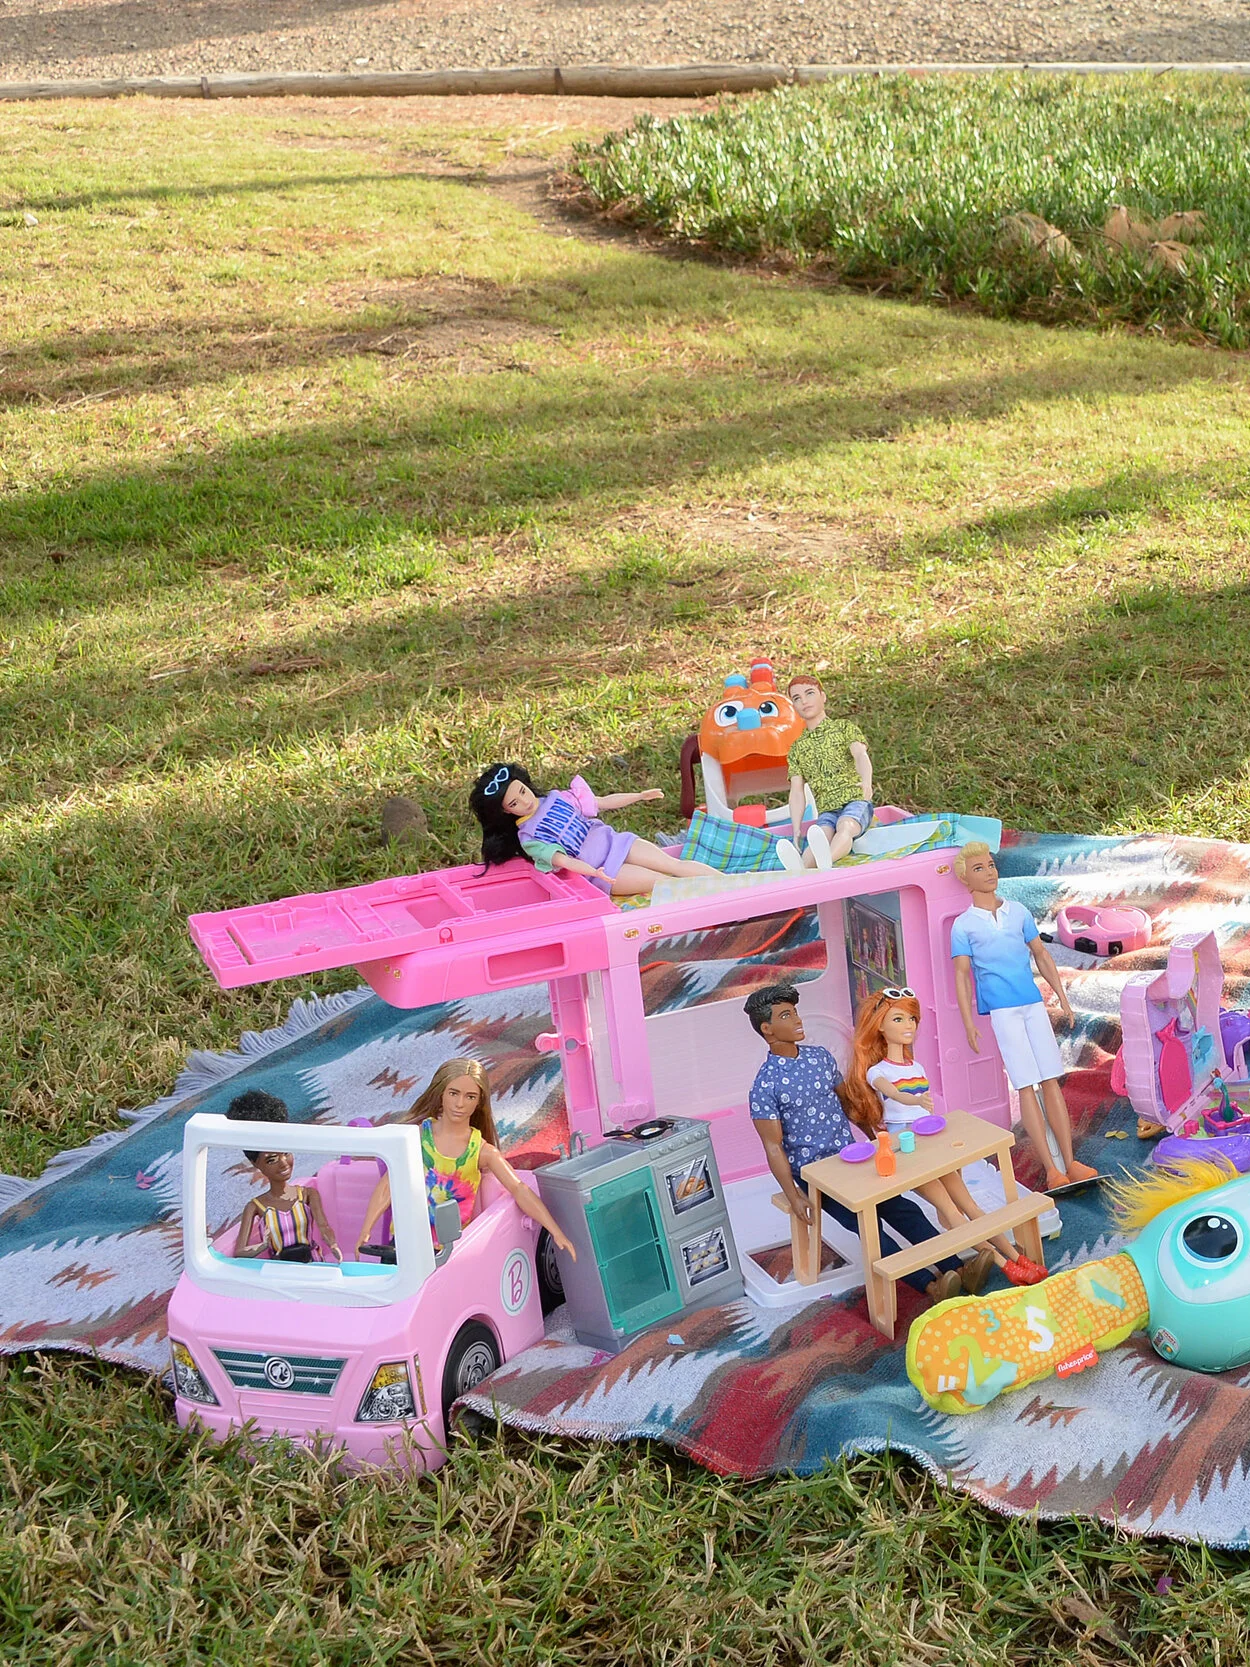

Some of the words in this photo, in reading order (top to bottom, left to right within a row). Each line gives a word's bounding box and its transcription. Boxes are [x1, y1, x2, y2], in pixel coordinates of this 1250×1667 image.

[534, 798, 575, 843] UNICORN
[508, 1260, 523, 1306] B
[980, 1308, 1000, 1333] 3
[1025, 1305, 1054, 1352] 5
[949, 1335, 1002, 1388] 2
